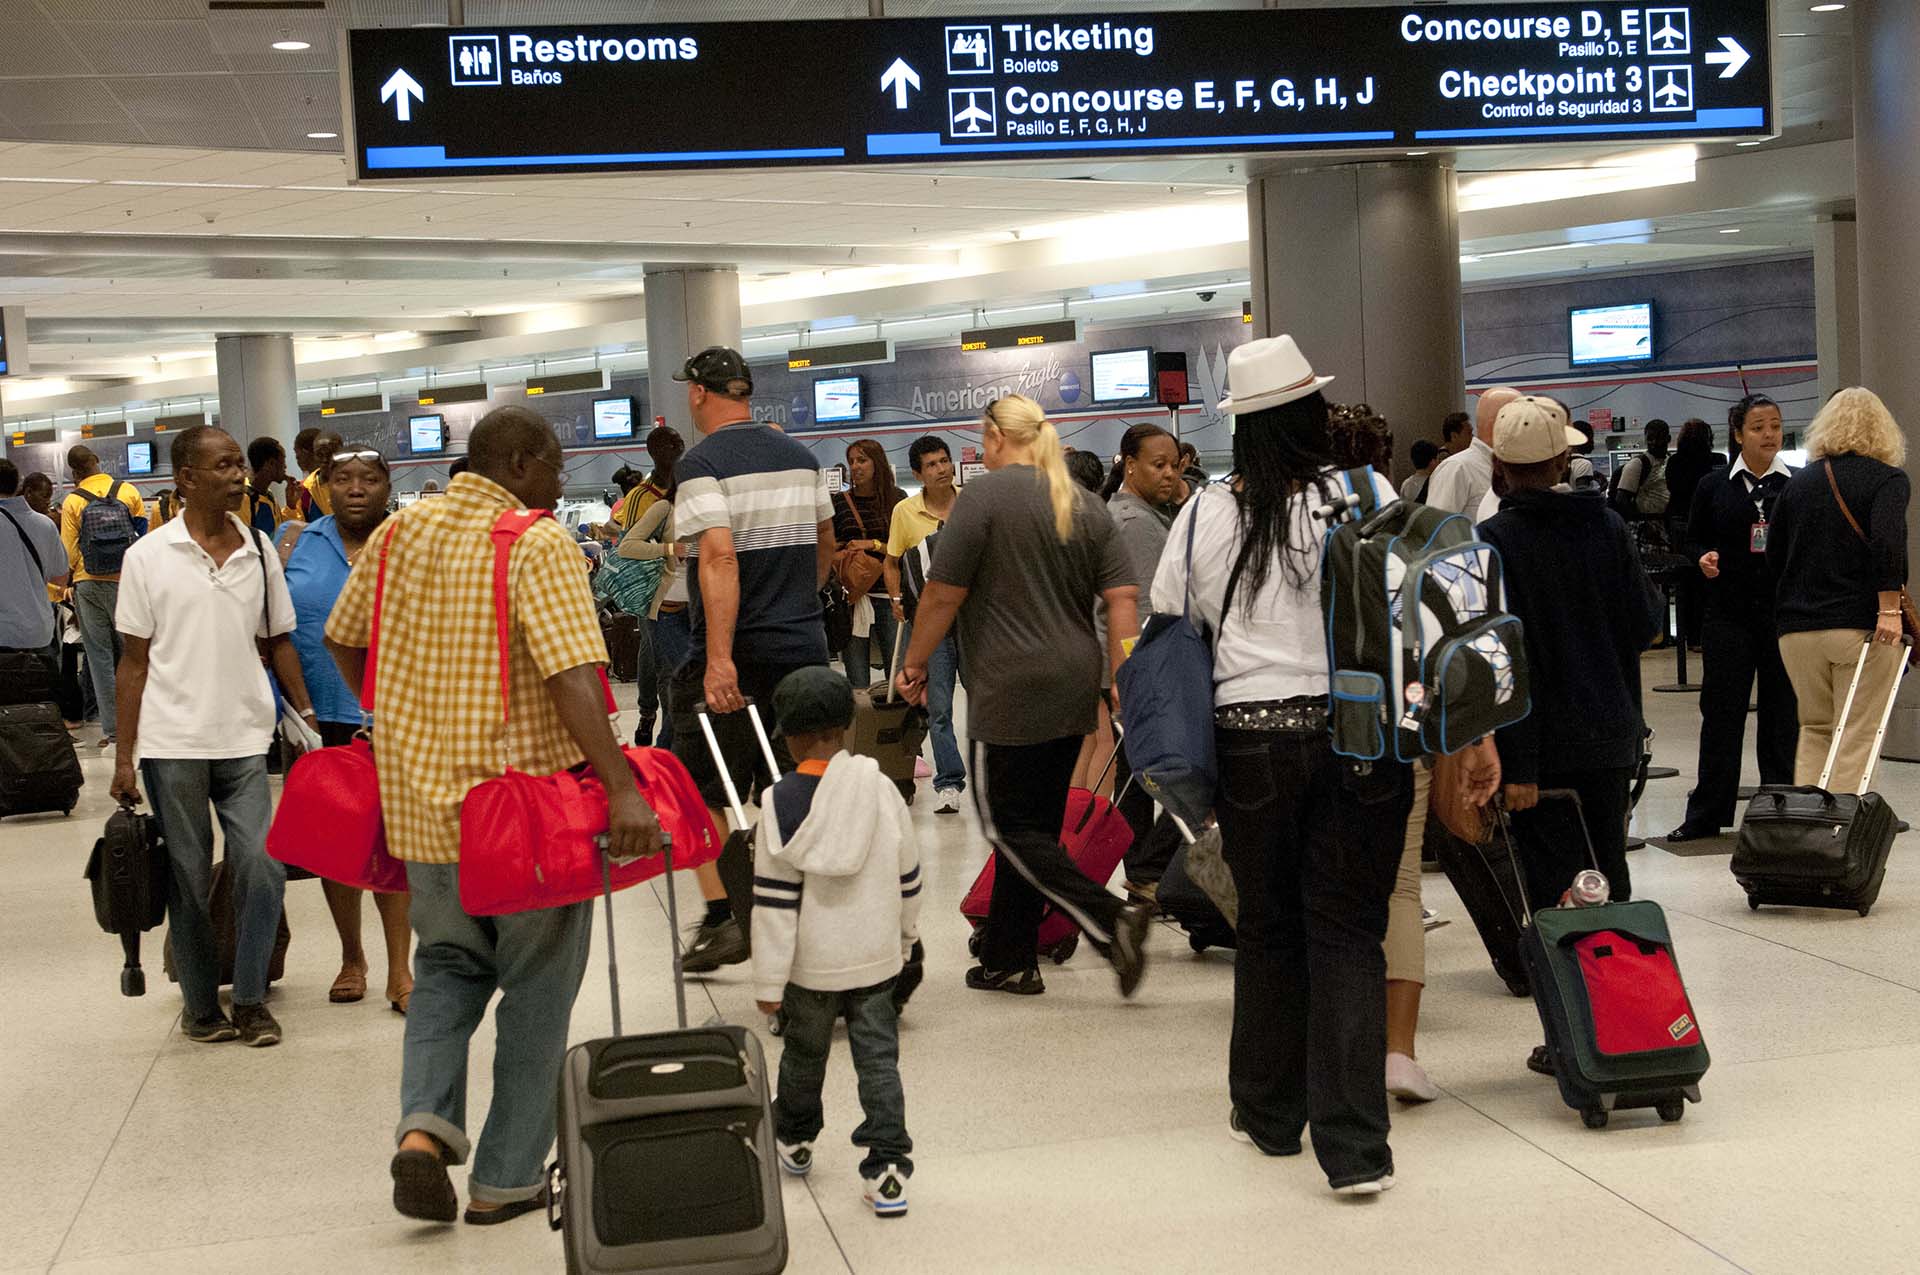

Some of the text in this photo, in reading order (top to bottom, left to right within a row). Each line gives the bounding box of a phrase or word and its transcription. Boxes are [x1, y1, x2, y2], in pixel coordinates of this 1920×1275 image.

[1401, 9, 1641, 42] Concourse D, E
[508, 34, 698, 63] Restrooms
[1002, 22, 1154, 56] Ticketing
[1559, 40, 1638, 58] Pasillo D, E
[1003, 58, 1059, 74] Boletos
[511, 69, 562, 85] Baños
[1439, 65, 1643, 103] Checkpoint 3
[1005, 76, 1374, 115] Concourse E, F, G, H, J
[1482, 98, 1643, 119] Control de Seguridad 3
[1006, 116, 1147, 137] Pasillo E, F, G, H, J
[962, 342, 987, 351] DOMESTIC
[1018, 336, 1044, 345] DOMESTIC
